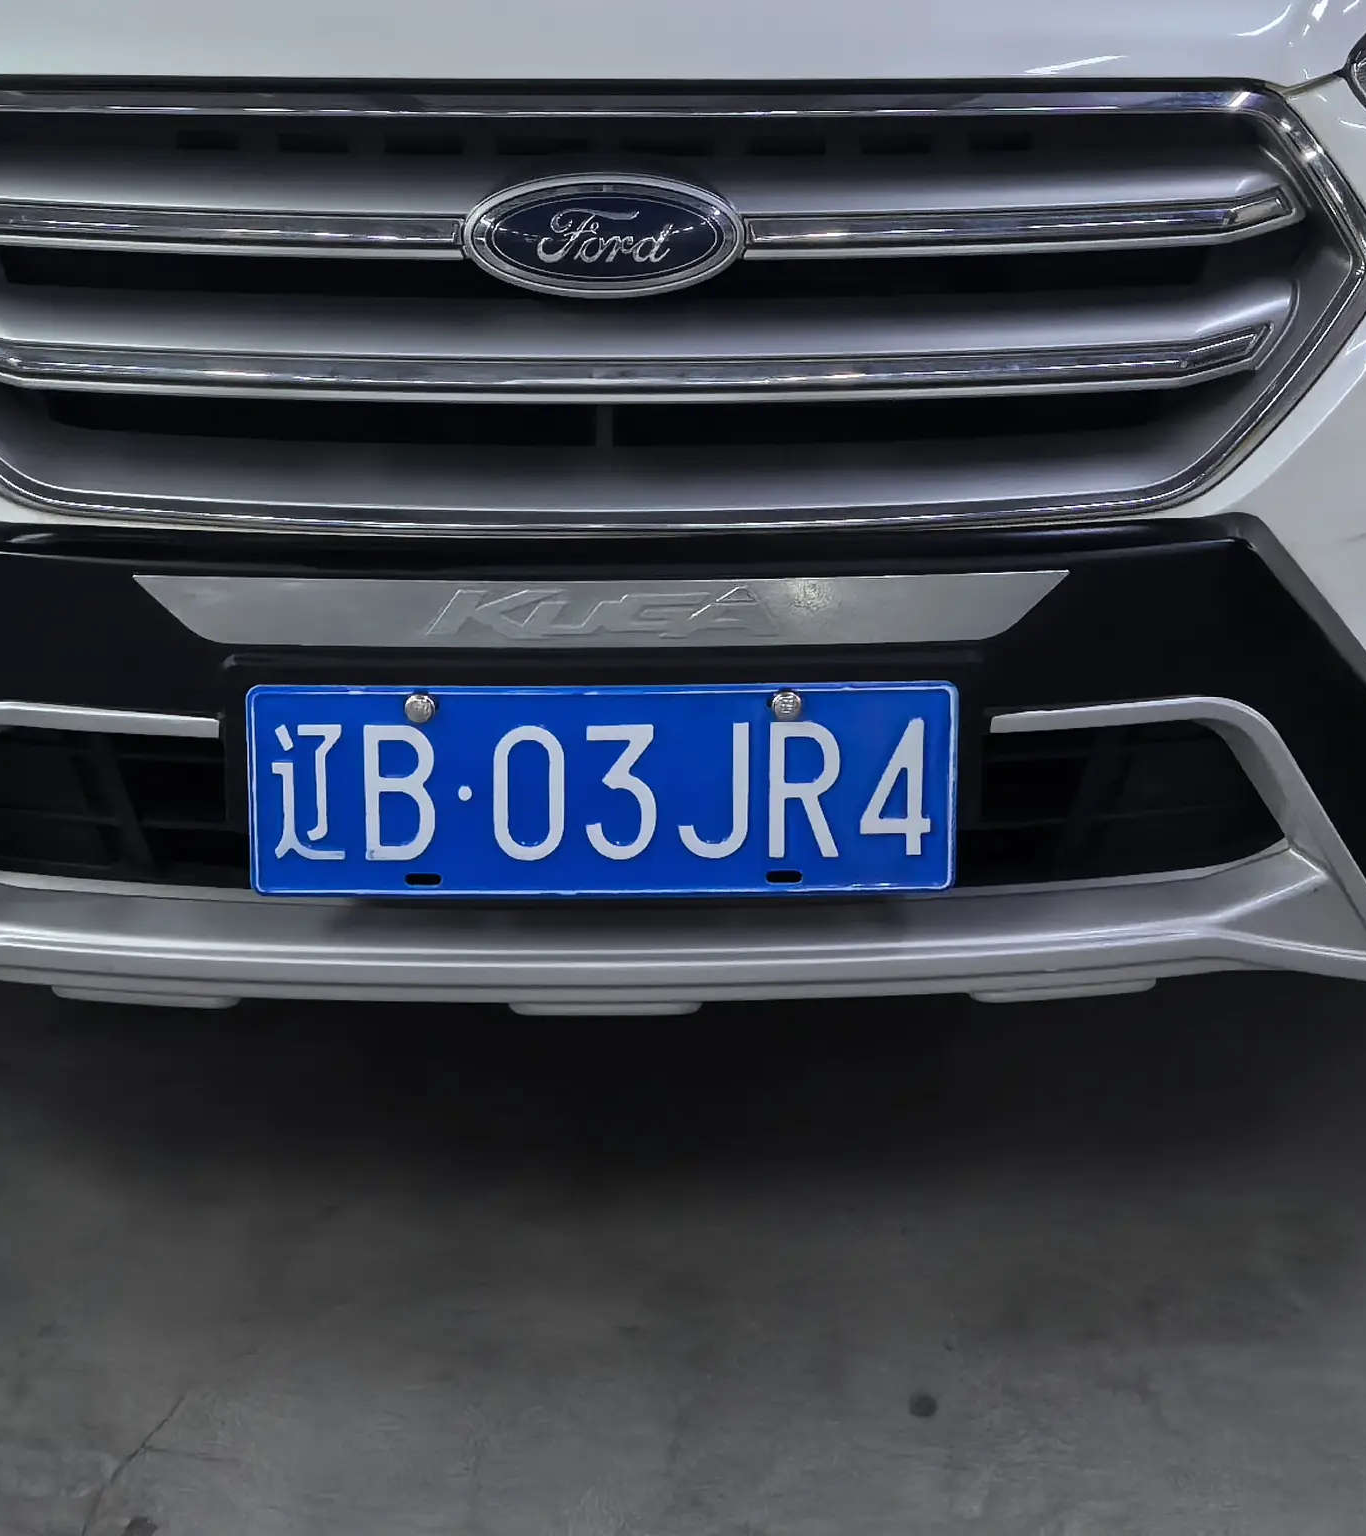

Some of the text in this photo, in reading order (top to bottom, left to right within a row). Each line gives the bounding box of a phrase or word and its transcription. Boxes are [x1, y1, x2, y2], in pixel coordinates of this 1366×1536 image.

[537, 208, 675, 264] Ford
[425, 584, 783, 641] KUGA
[272, 719, 932, 862] 辽B·03JR4
